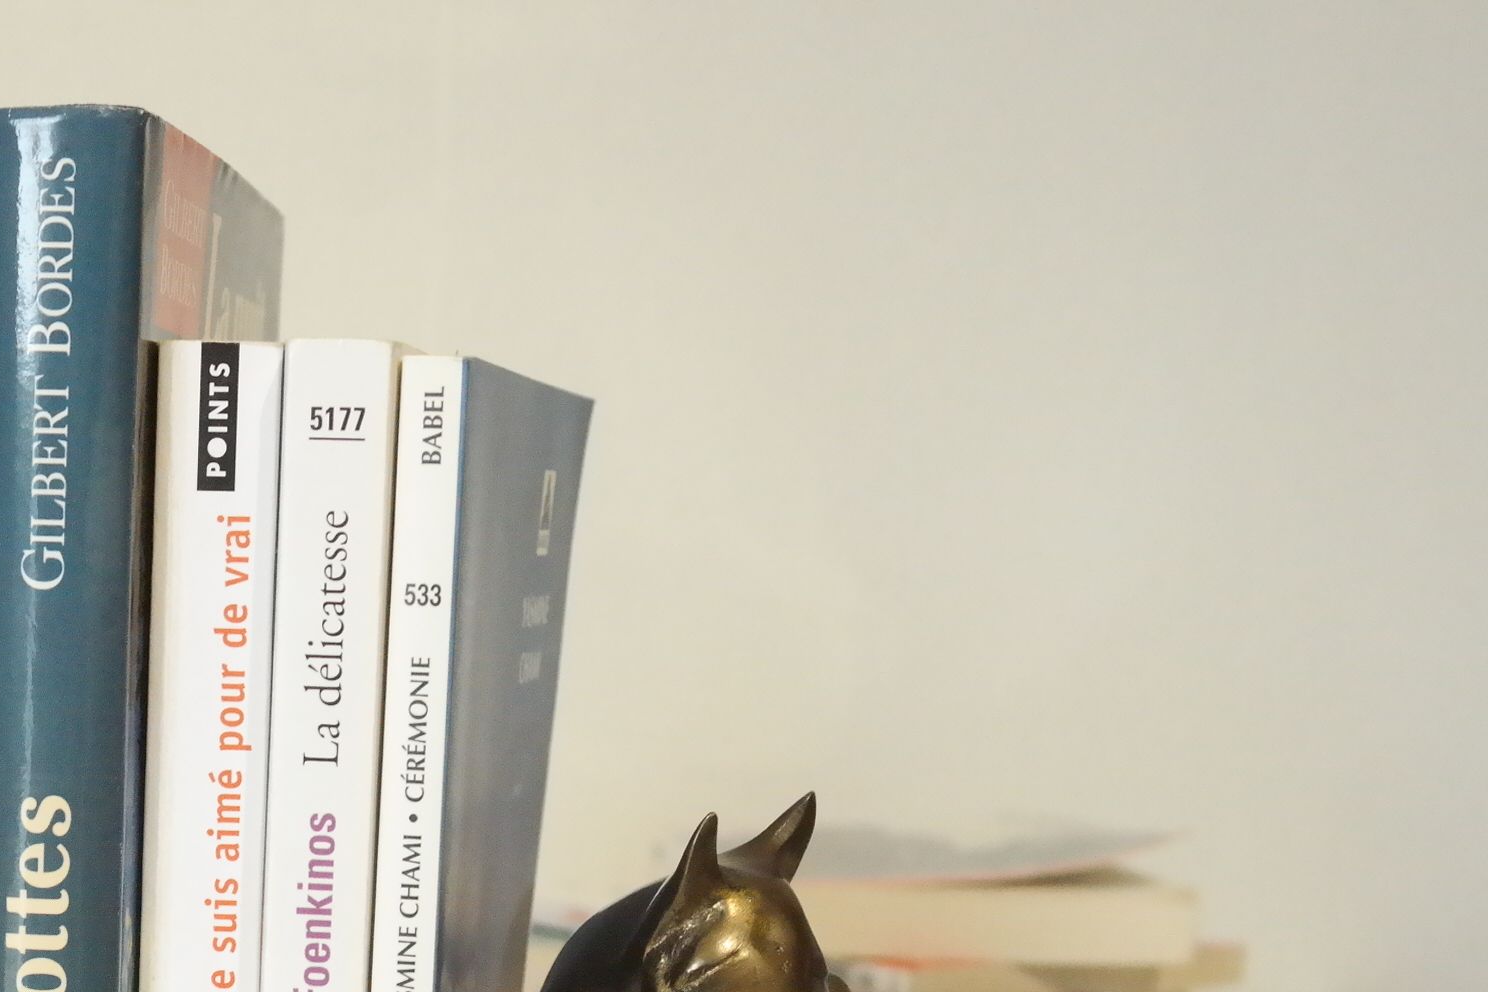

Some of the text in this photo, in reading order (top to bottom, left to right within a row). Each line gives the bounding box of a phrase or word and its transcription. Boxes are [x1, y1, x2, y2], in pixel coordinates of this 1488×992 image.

[20, 156, 77, 591] GILBERT BORDES
[205, 361, 230, 478] POINTS
[309, 406, 366, 433] 5177
[421, 385, 445, 466] BABEL
[216, 514, 251, 587] vrai
[214, 603, 247, 647] de
[304, 509, 349, 707] délicatesse
[404, 583, 442, 607] 533
[218, 663, 251, 751] pour
[302, 720, 341, 767] La
[400, 656, 431, 803] CÉRÉMONIE
[207, 769, 242, 861] aimé
[205, 878, 238, 953] suis
[400, 834, 422, 919] CHAMI
